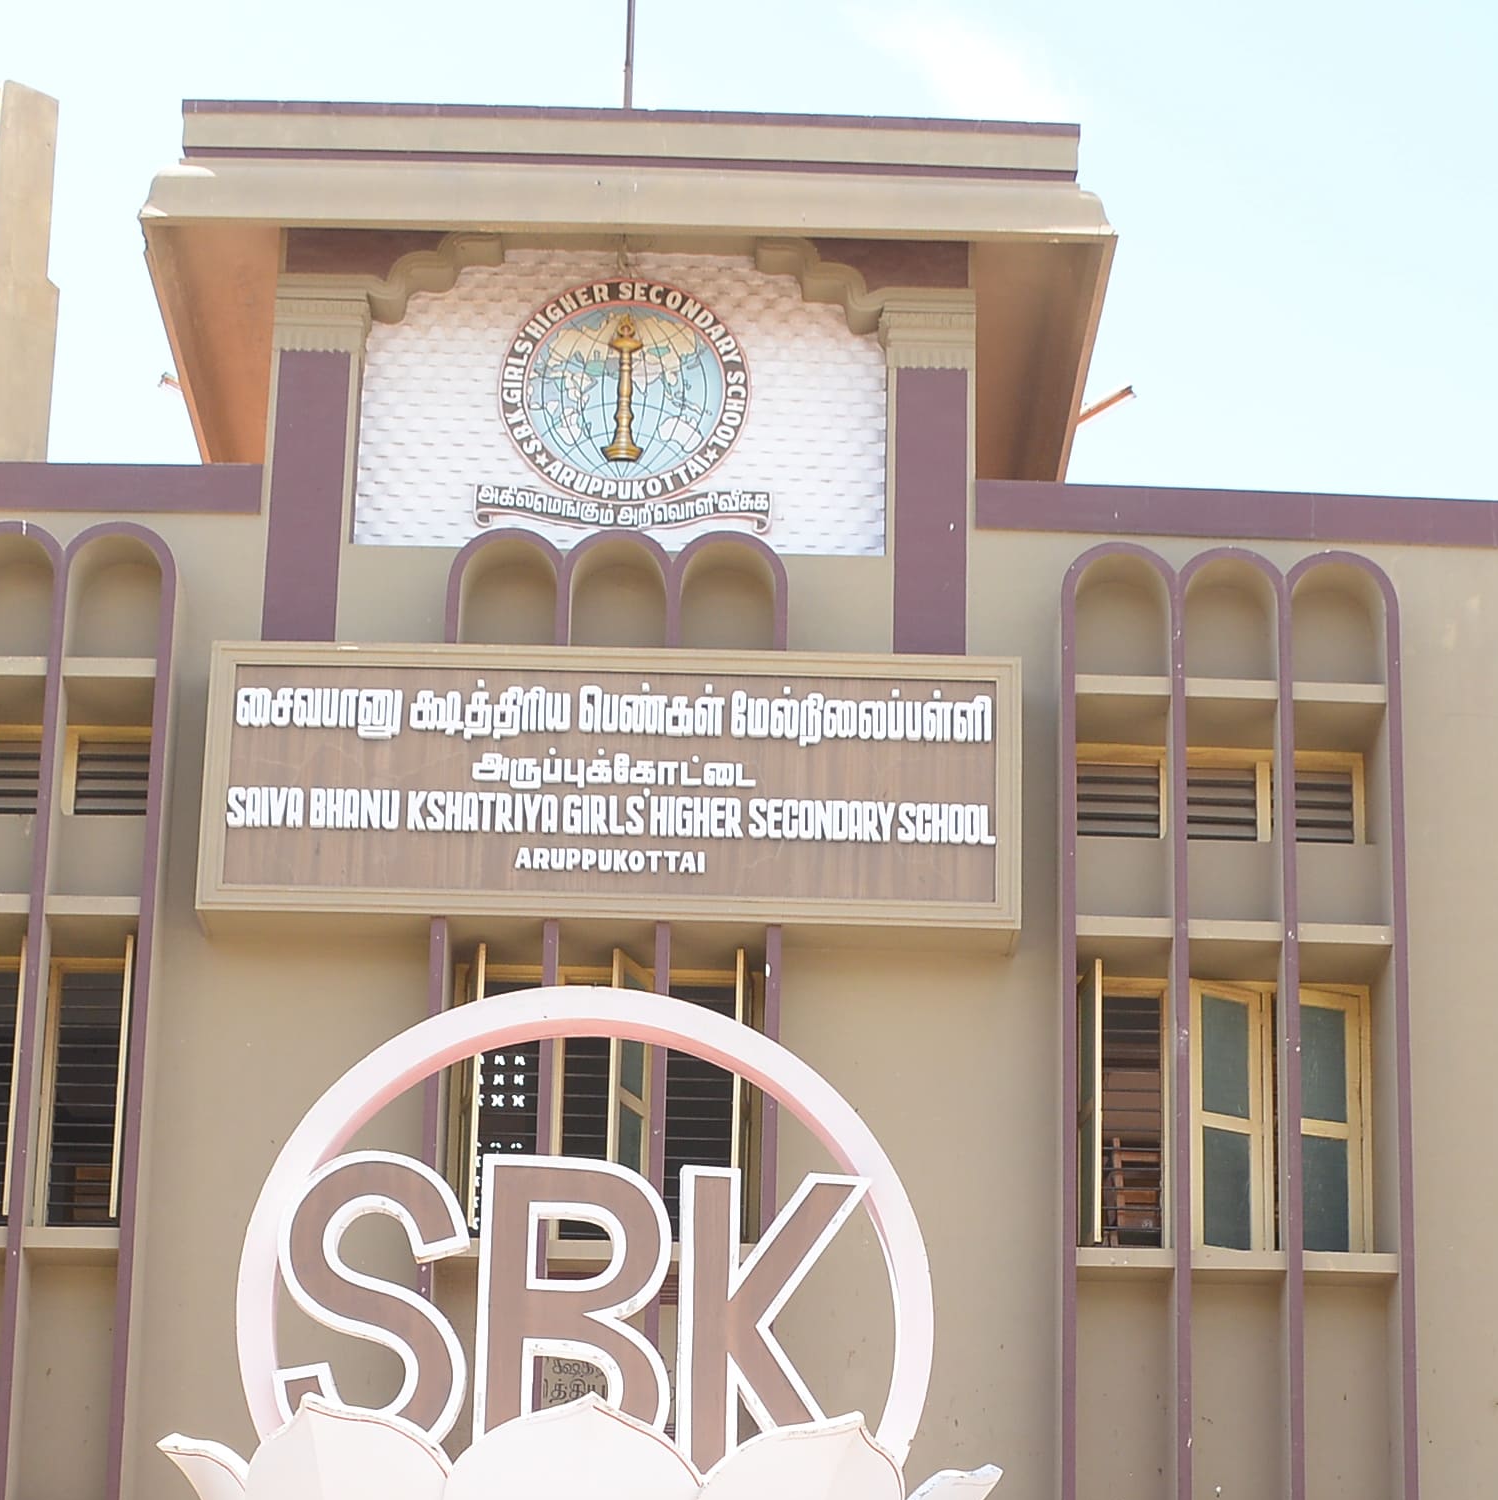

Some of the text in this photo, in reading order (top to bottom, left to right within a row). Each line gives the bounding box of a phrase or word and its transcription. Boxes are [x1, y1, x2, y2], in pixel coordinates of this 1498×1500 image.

[525, 283, 612, 341] HIGHER
[619, 282, 742, 364] SECONDARY
[708, 370, 747, 449] SCHOOL
[544, 454, 711, 500] ARUPPUKOTTAI
[235, 687, 403, 739] சைவபானு
[579, 682, 725, 738] பெண்கள்
[731, 686, 993, 746] மேல்நிலைப்பள்ளி
[472, 747, 757, 790] அருப்புக்கோட்டை
[226, 787, 303, 828] SAIVA
[309, 788, 400, 830] BHANU
[407, 790, 558, 834] KSHATRIYA
[650, 796, 743, 839] HIGHER
[749, 799, 895, 842] SECONDARY
[898, 803, 997, 846] SCHOOL
[515, 847, 706, 873] ARUPPUKOTTAI
[273, 1150, 870, 1474] SBK
